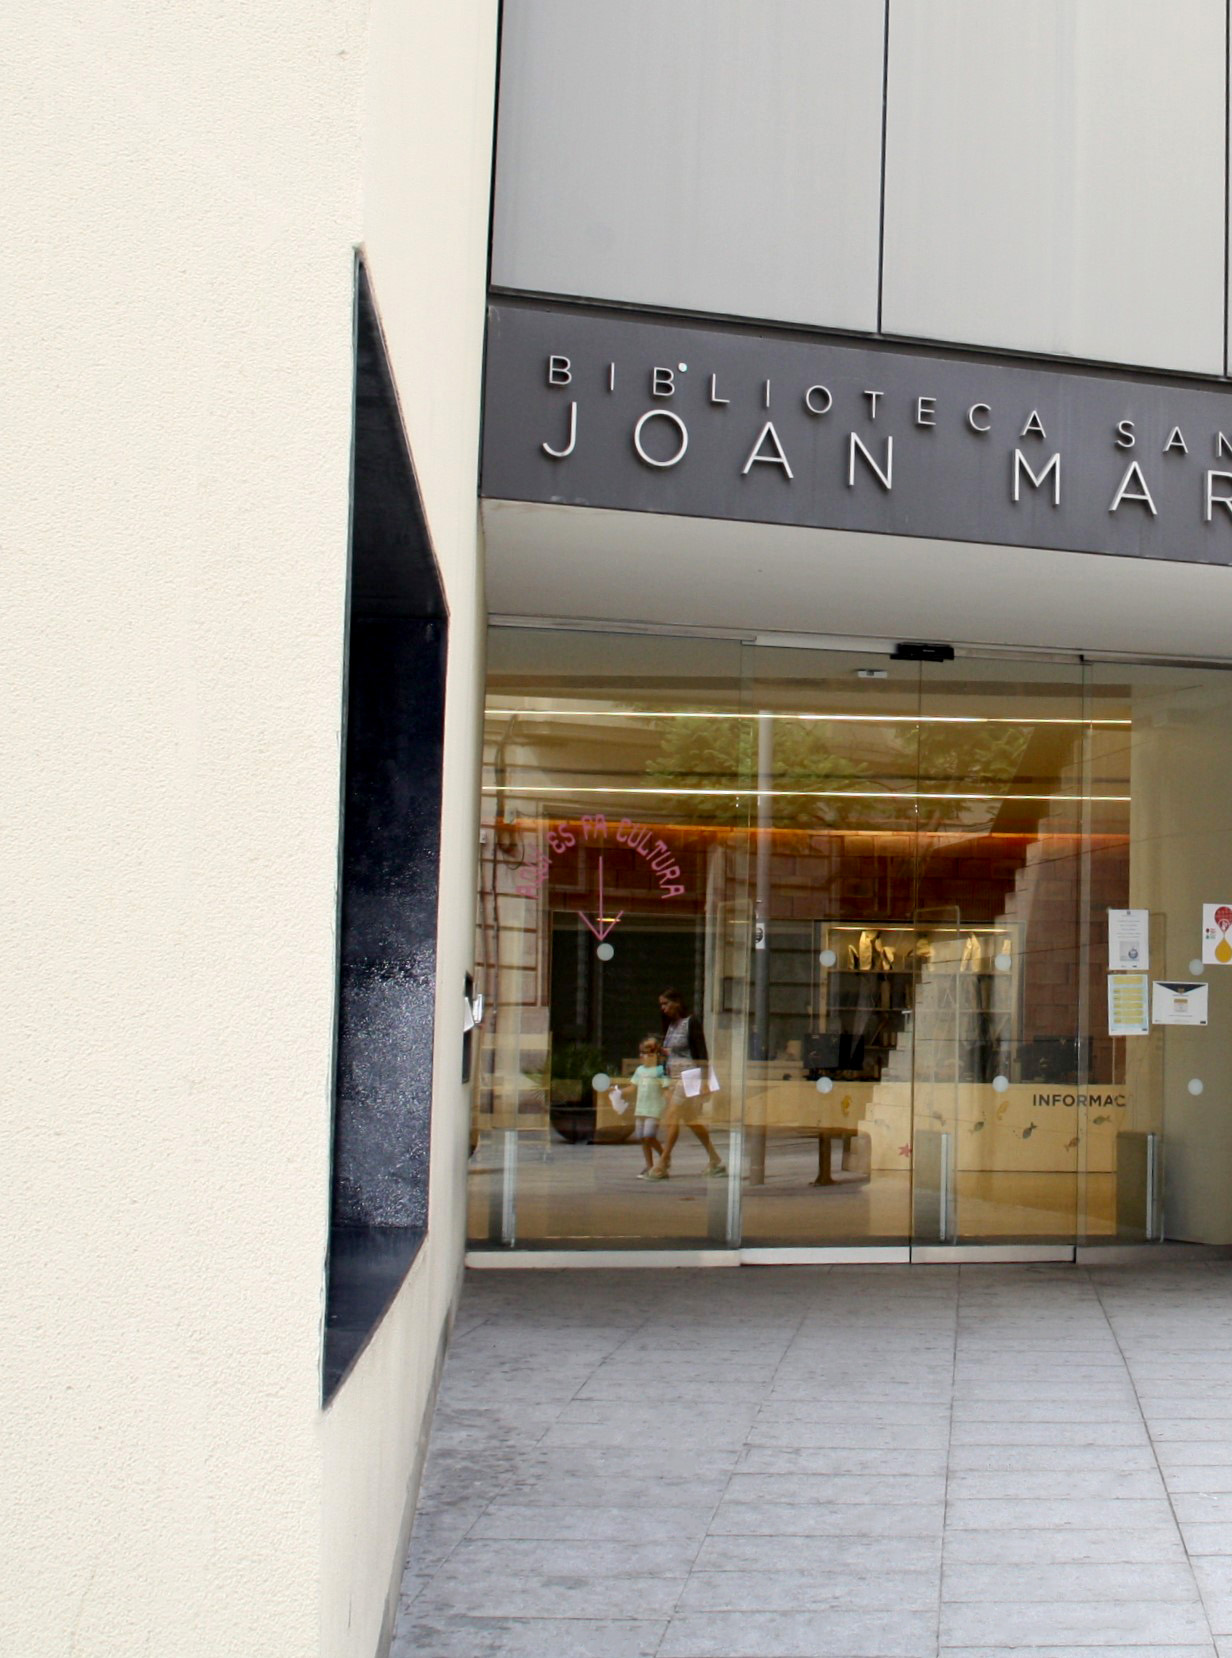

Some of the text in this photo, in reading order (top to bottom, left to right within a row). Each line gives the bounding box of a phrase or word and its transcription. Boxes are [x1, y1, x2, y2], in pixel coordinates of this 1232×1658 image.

[548, 355, 1047, 439] BIBLIOTECA
[542, 402, 893, 490] JOAN
[547, 823, 576, 854] ES
[582, 814, 608, 840] FA
[616, 817, 685, 899] CULTURA
[1033, 1094, 1126, 1108] INFORMAC
